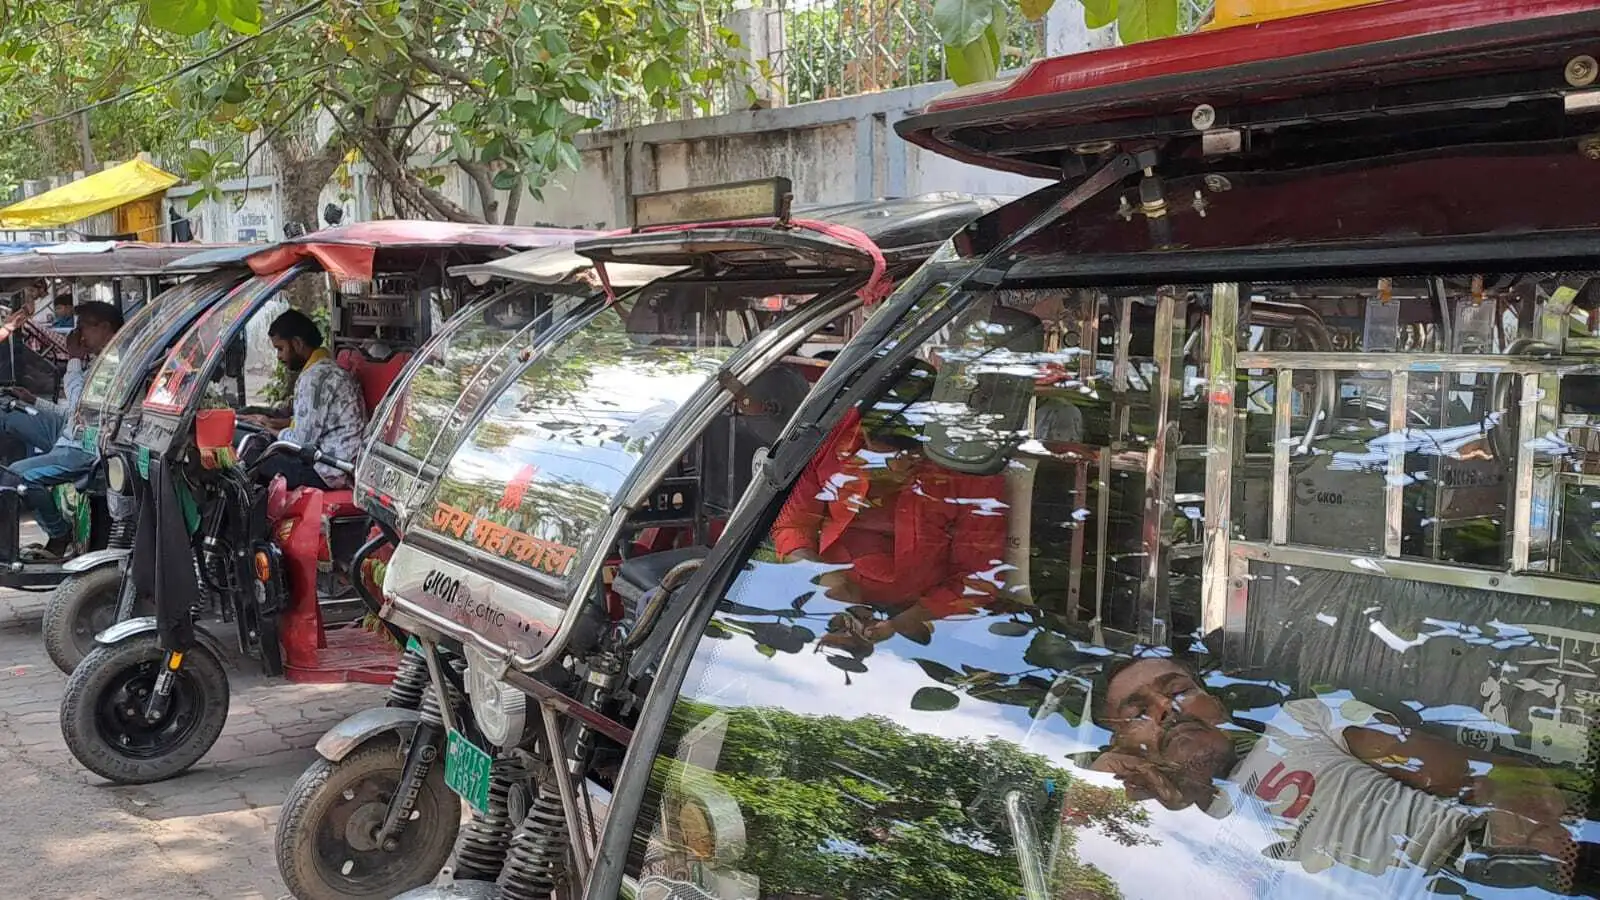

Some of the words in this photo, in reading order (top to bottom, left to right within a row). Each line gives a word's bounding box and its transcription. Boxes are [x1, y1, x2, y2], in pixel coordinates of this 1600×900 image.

[432, 501, 473, 538] जय
[474, 518, 577, 575] महाकाल
[1286, 805, 1320, 857] COMPANY
